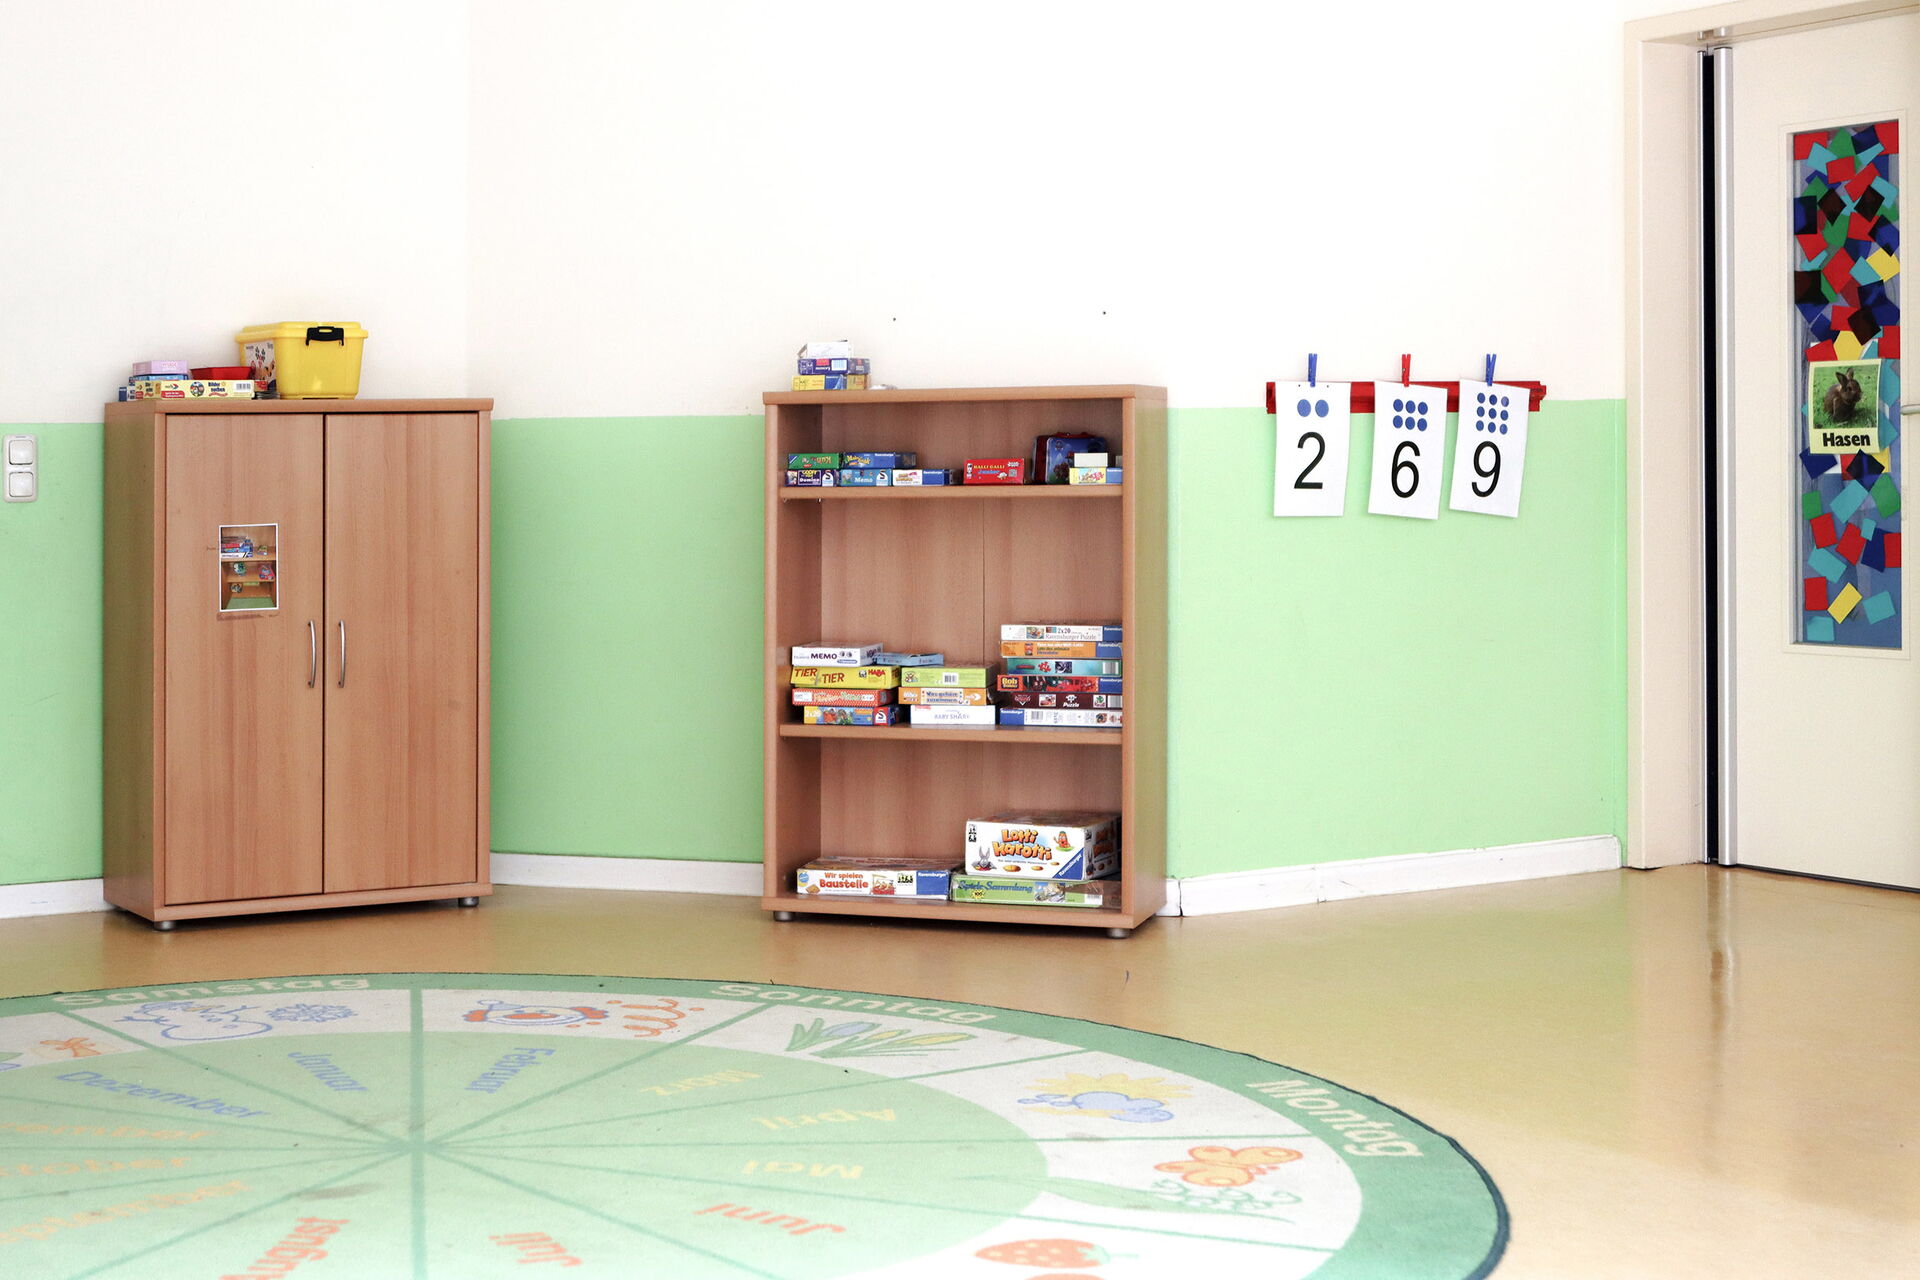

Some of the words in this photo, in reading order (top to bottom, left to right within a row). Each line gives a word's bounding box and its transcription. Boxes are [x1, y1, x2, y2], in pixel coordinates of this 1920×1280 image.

[1822, 432, 1871, 447] Hasen
[1293, 431, 1325, 490] 2
[1391, 441, 1420, 498] 6
[1471, 441, 1501, 498] 9
[794, 668, 818, 677] TIER
[822, 672, 845, 683] TIER
[868, 669, 886, 677] HABA
[1001, 829, 1038, 843] Lotti
[991, 841, 1052, 861] Karotti
[838, 872, 863, 880] spielen
[1058, 854, 1082, 877] Ravensburger
[819, 879, 869, 889] Baustelle
[53, 978, 370, 1006] Samstag
[711, 984, 997, 1023] Sonntag
[288, 1052, 368, 1093] Januar
[465, 1047, 557, 1094] Februar
[55, 1071, 271, 1118] Dezember
[752, 1108, 897, 1131] April
[1246, 1080, 1425, 1158] Montag
[742, 1160, 863, 1179] Mai
[693, 1203, 847, 1236] Juni
[488, 1232, 583, 1267] Juli
